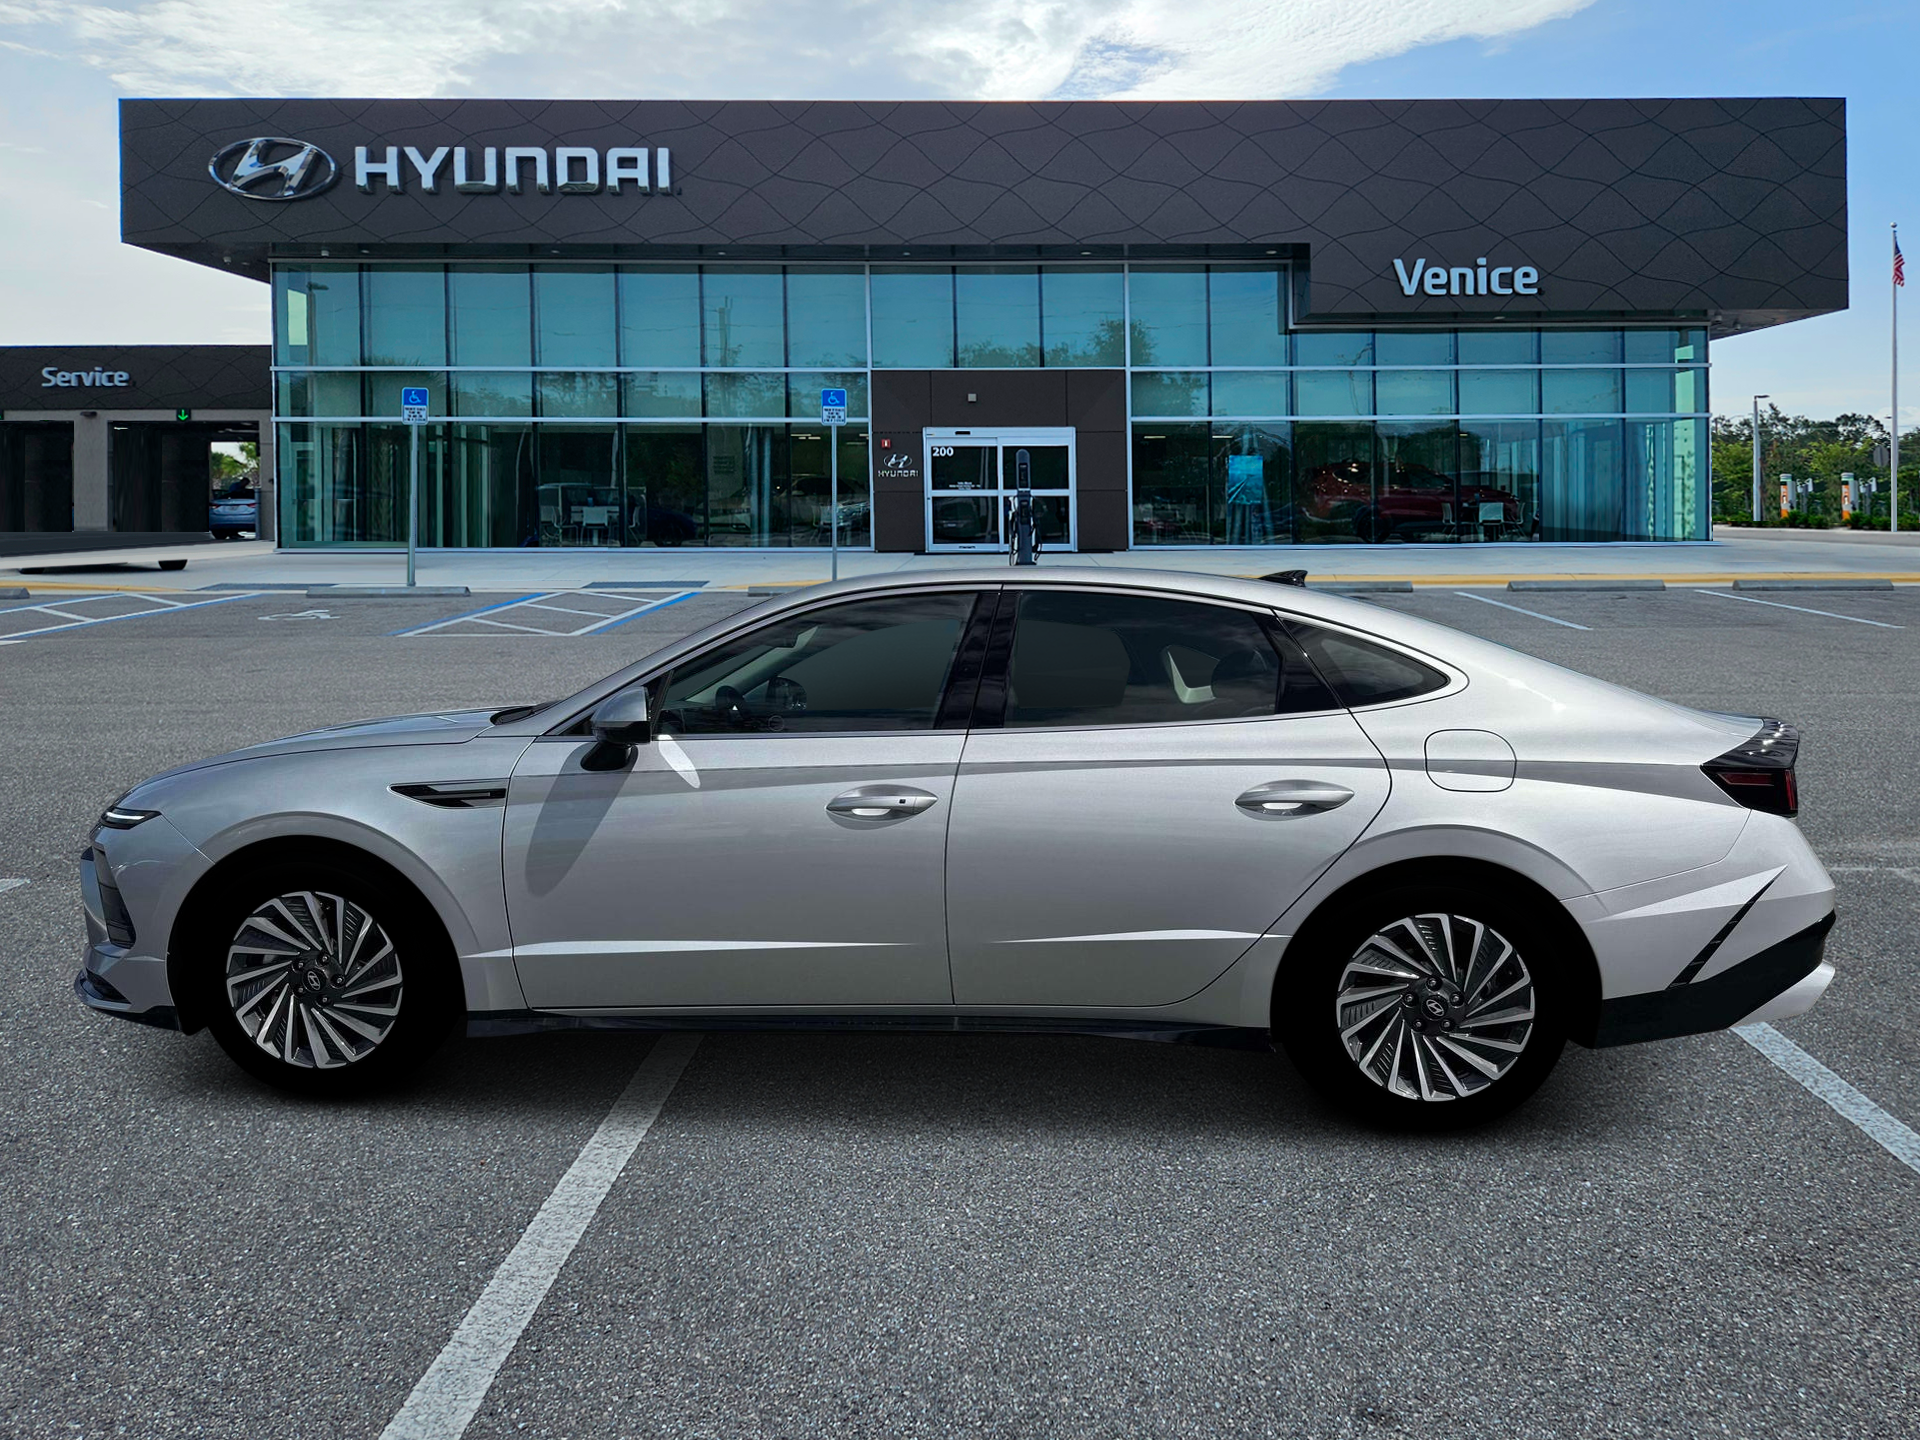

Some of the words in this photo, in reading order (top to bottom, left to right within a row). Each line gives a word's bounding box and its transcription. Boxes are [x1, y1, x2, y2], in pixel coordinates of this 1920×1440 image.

[355, 146, 671, 193] HYUNDAI
[1392, 257, 1539, 296] Venice
[41, 366, 130, 387] Service
[932, 447, 954, 457] 200
[877, 470, 919, 478] HYUNDAI
